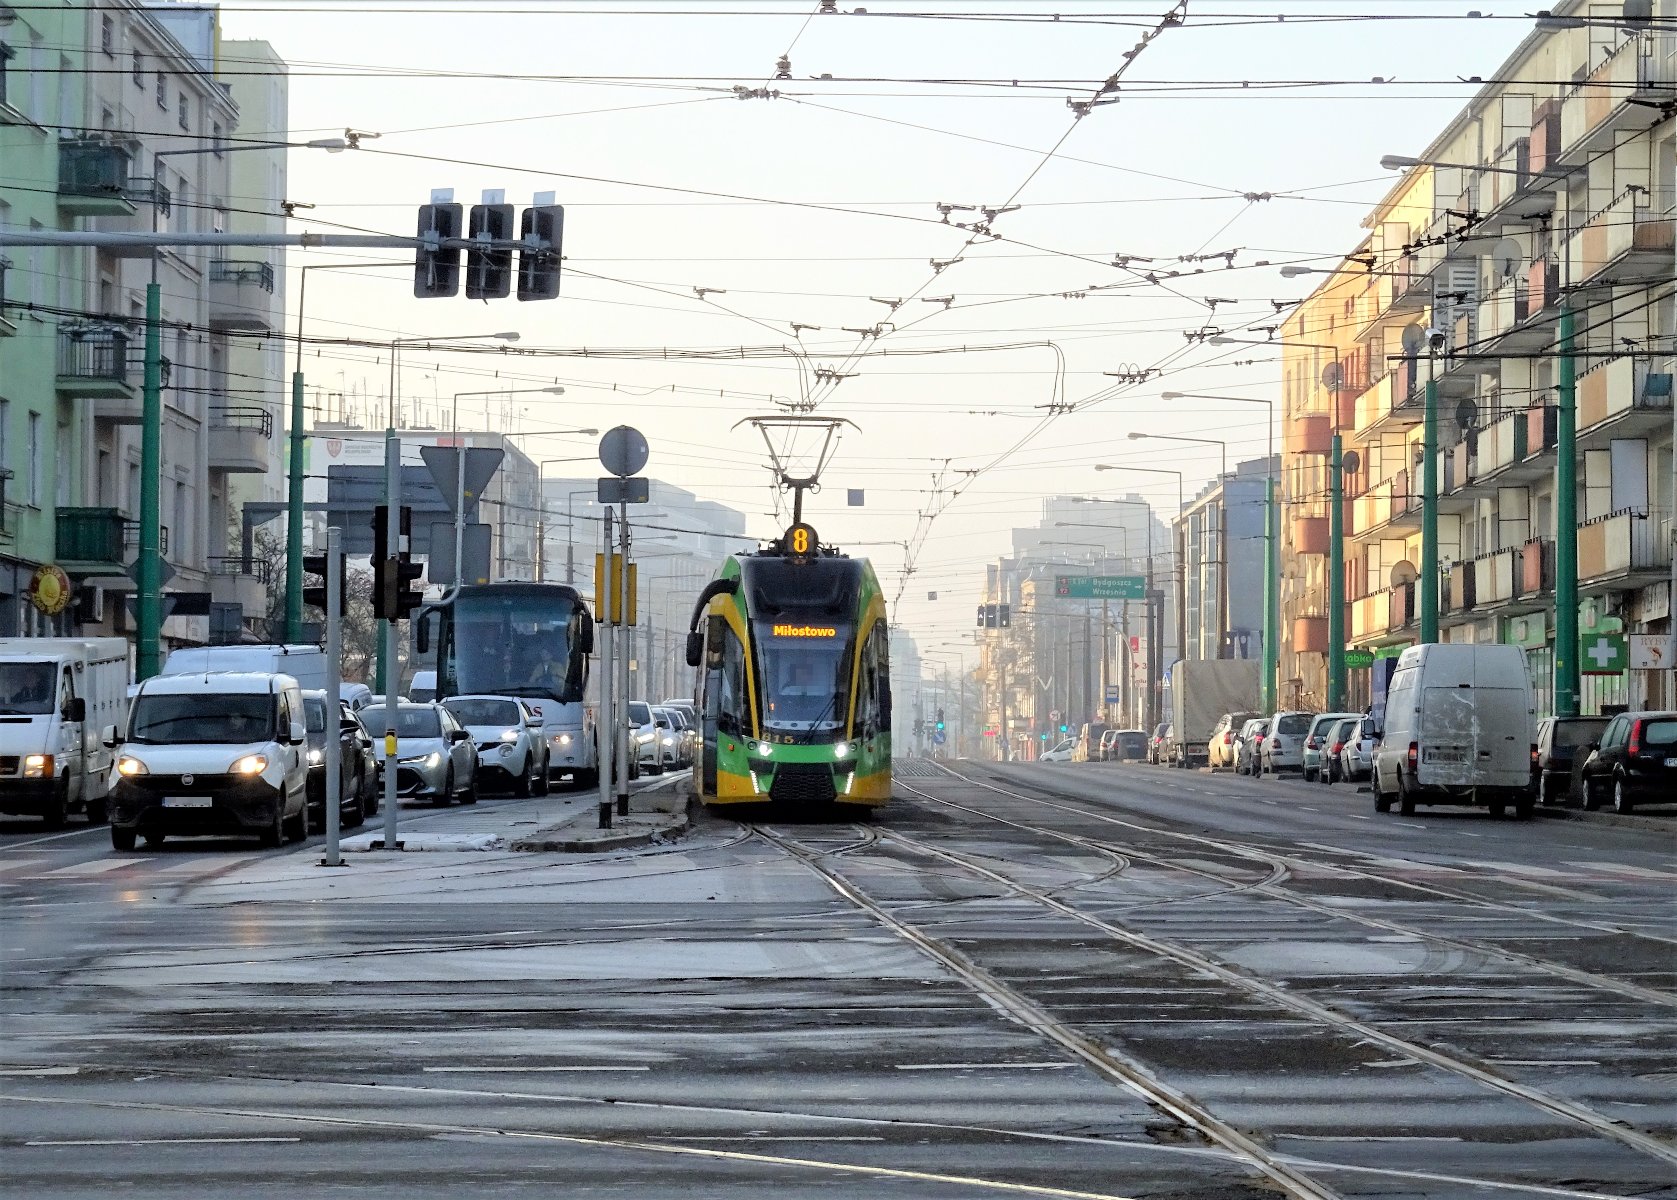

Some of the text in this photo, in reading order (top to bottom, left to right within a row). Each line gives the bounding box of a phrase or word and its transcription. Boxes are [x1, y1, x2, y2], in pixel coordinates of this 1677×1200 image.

[793, 527, 808, 553] 8
[1092, 578, 1132, 587] Bydgoszcz
[773, 625, 836, 637] Miłostowo
[1641, 636, 1669, 646] RYBY
